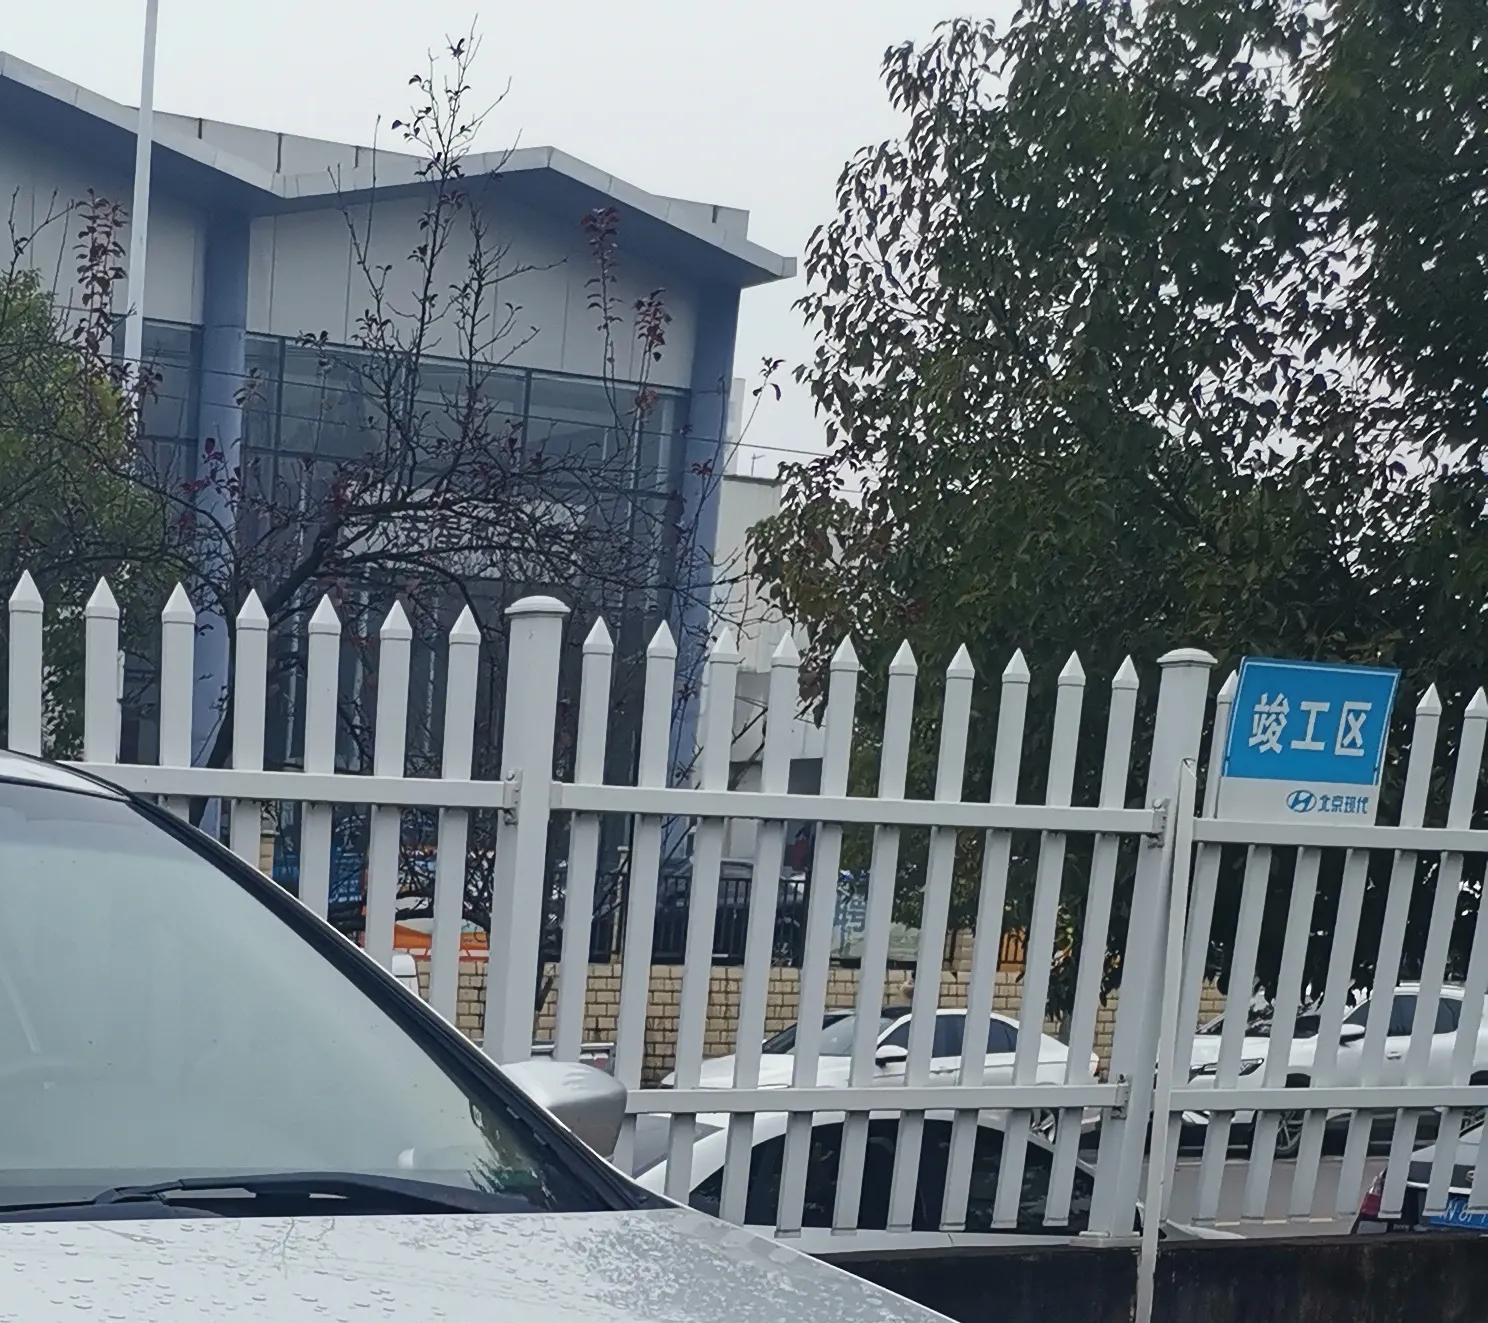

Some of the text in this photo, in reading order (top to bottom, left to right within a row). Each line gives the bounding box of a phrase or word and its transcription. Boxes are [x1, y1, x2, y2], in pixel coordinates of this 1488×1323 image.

[1248, 692, 1373, 757] 竣工区
[1317, 794, 1369, 815] 北京现代
